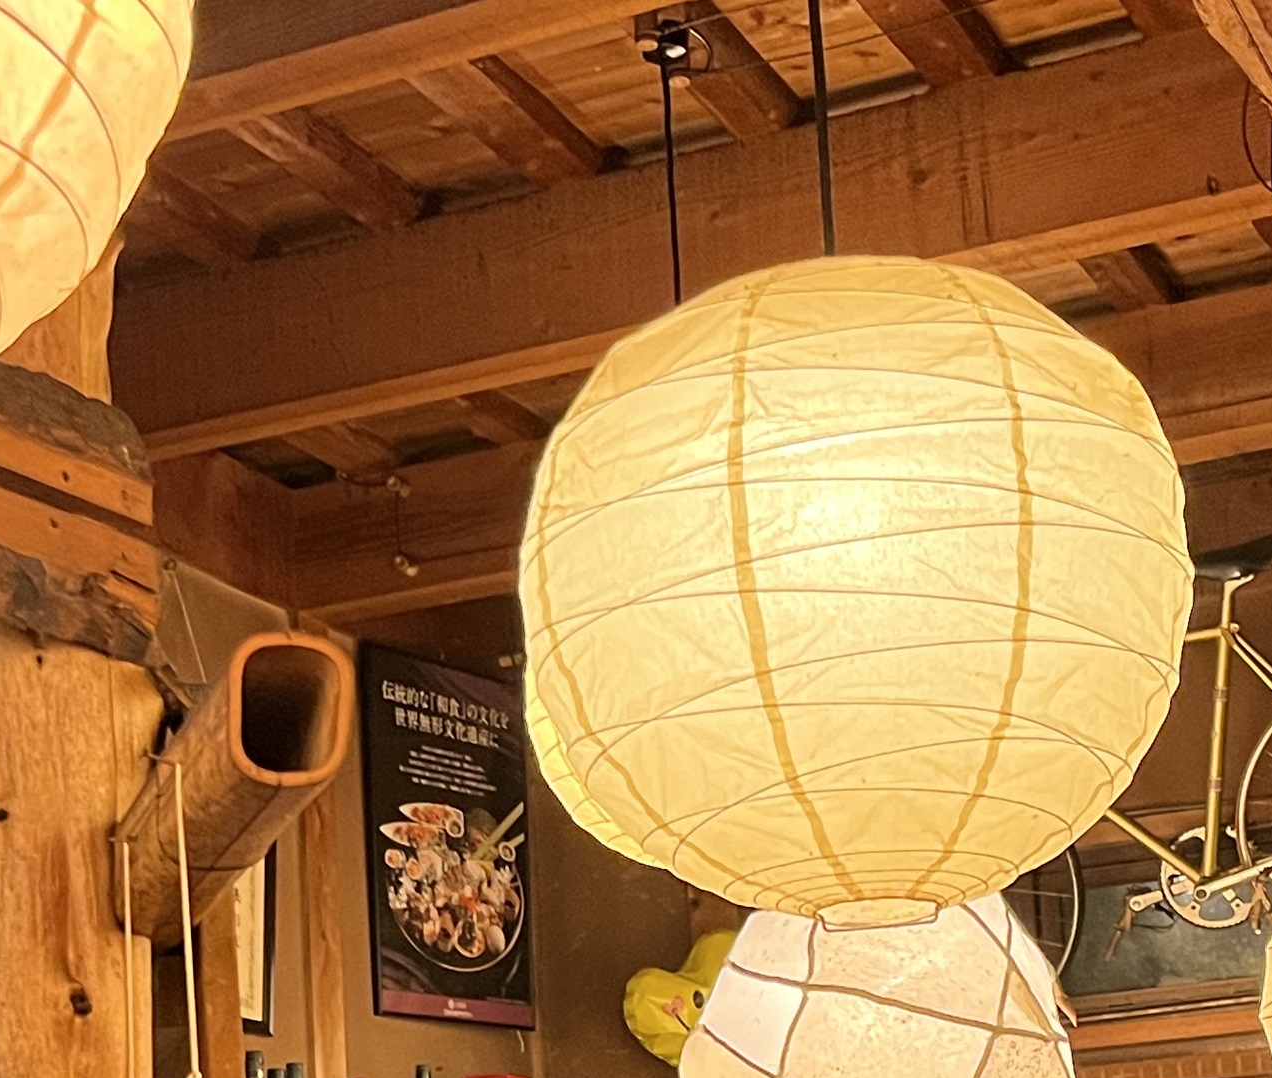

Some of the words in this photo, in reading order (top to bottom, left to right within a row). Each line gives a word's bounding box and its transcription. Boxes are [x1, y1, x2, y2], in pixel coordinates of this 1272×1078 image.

[382, 680, 510, 730] 伝統的な「和食」の文化を
[394, 706, 500, 748] 世界無形文化遺産に
